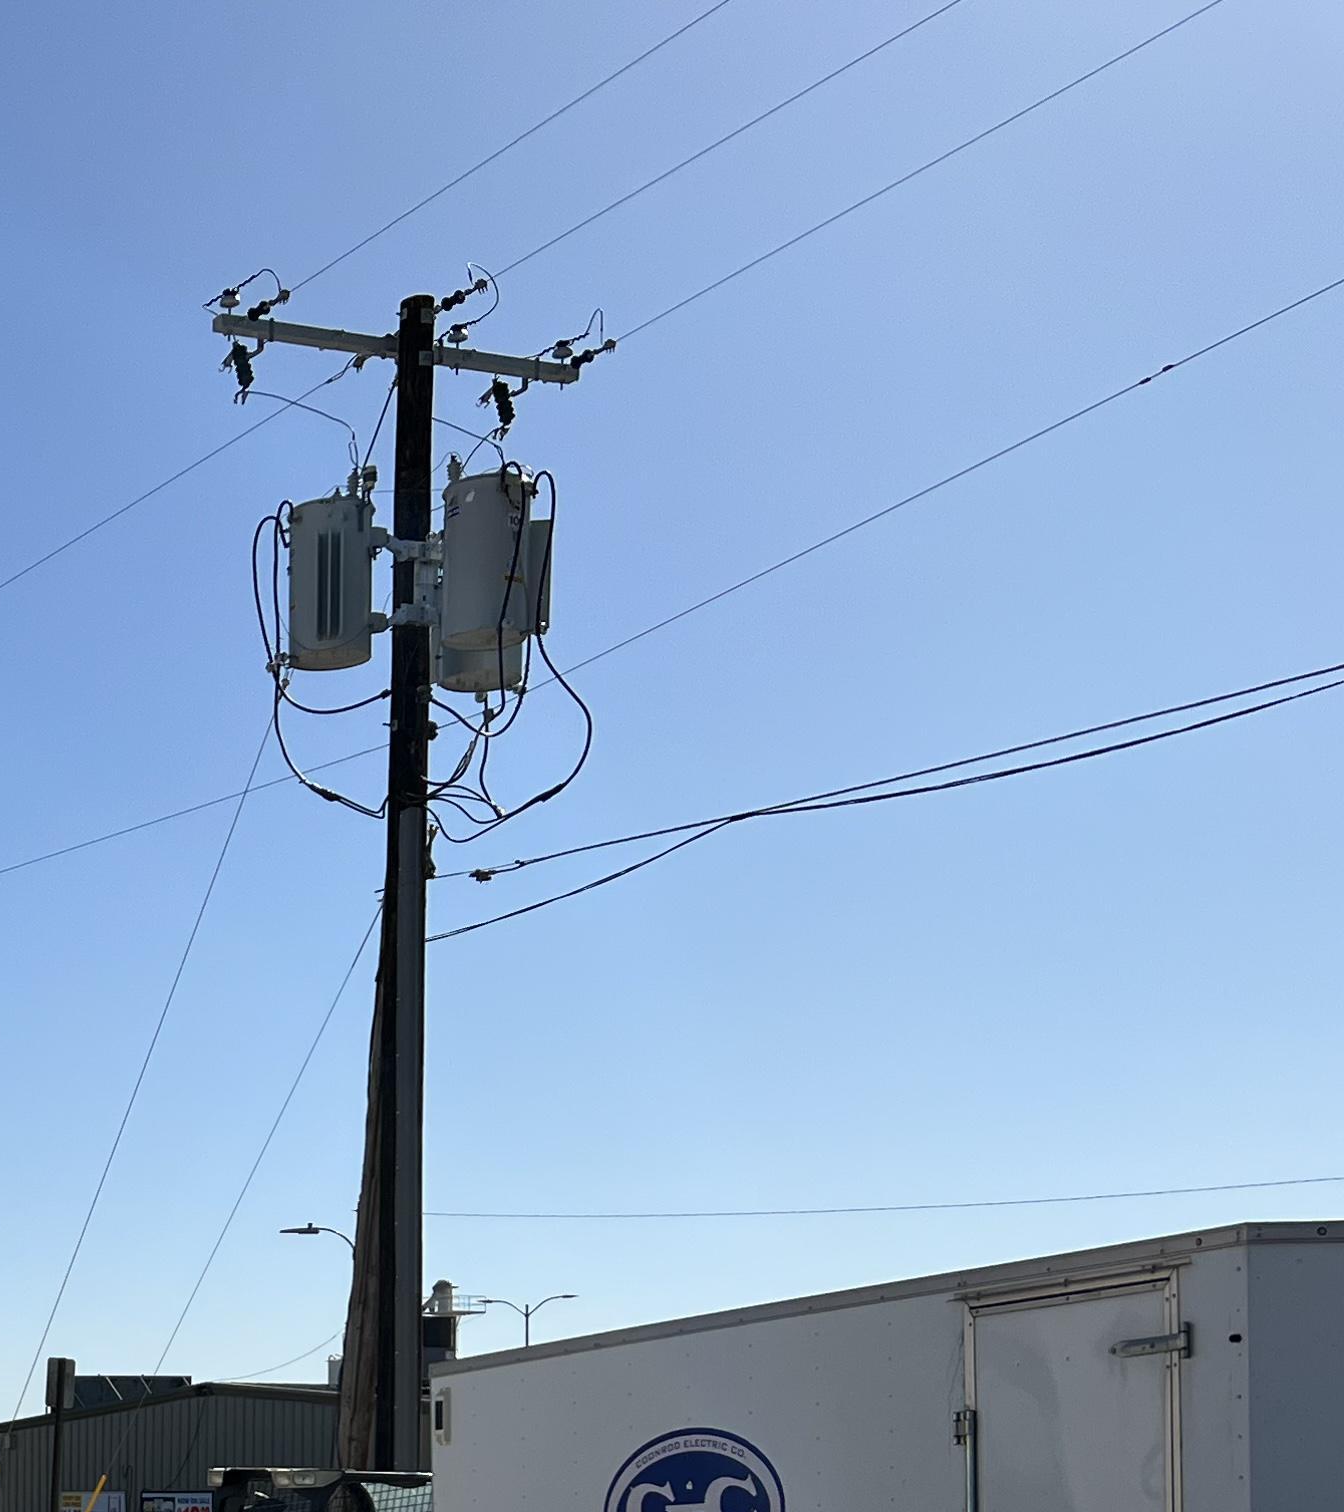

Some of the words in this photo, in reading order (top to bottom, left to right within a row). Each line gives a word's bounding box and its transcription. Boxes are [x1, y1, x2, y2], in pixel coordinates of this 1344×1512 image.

[635, 1441, 681, 1469] COONROD
[683, 1438, 728, 1452] ELECTRIC
[730, 1445, 747, 1460] CO.
